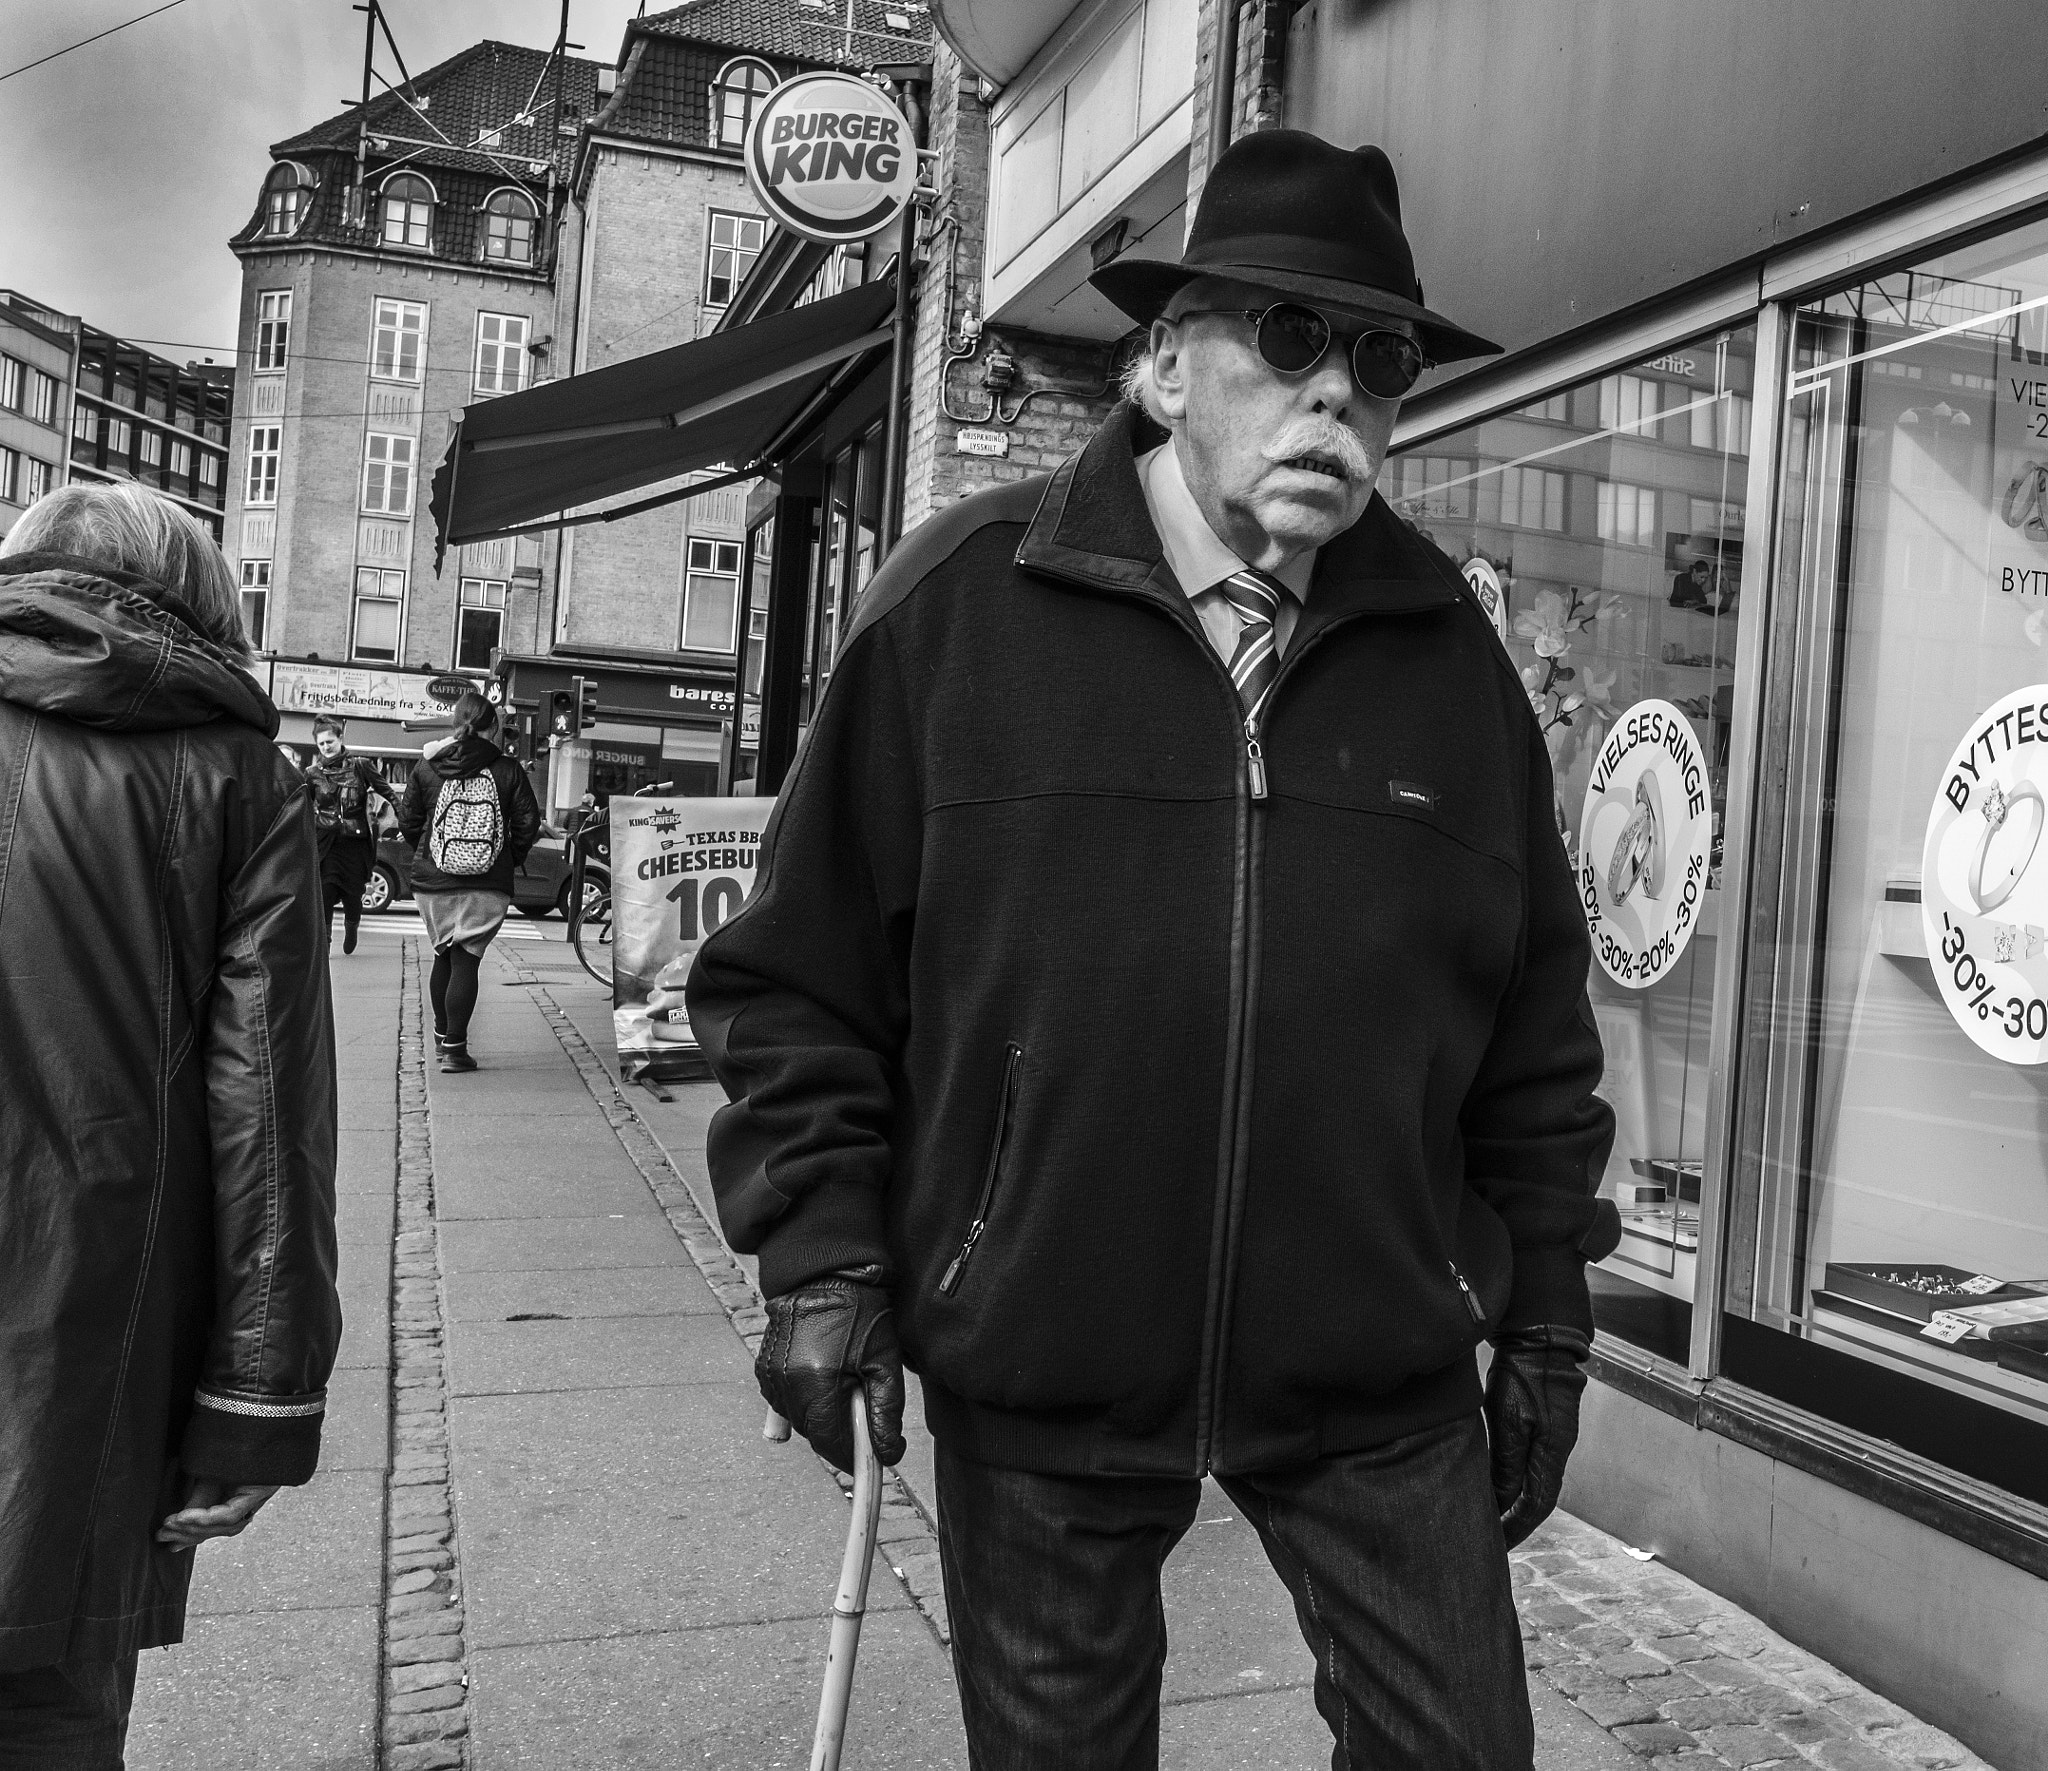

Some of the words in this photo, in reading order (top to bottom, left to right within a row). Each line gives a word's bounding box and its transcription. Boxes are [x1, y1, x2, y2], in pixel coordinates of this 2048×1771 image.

[771, 113, 899, 144] BURGER
[769, 141, 901, 185] KING
[300, 690, 397, 710] Fritidsbeklædning
[399, 699, 414, 709] fra
[1591, 713, 1663, 794] VIELSES
[1663, 719, 1706, 820] RINGE
[628, 817, 650, 828] KING
[650, 813, 681, 826] SAVERS
[685, 830, 736, 846] TEXAS
[739, 830, 764, 844] BB
[637, 848, 760, 881] CHEESEBU
[665, 876, 744, 941] 10
[1582, 852, 1602, 934] -20%
[1598, 932, 1634, 980] -30%
[1632, 930, 1675, 980] -20%
[1674, 853, 1703, 935] -30%
[1941, 911, 1996, 1021] -30%
